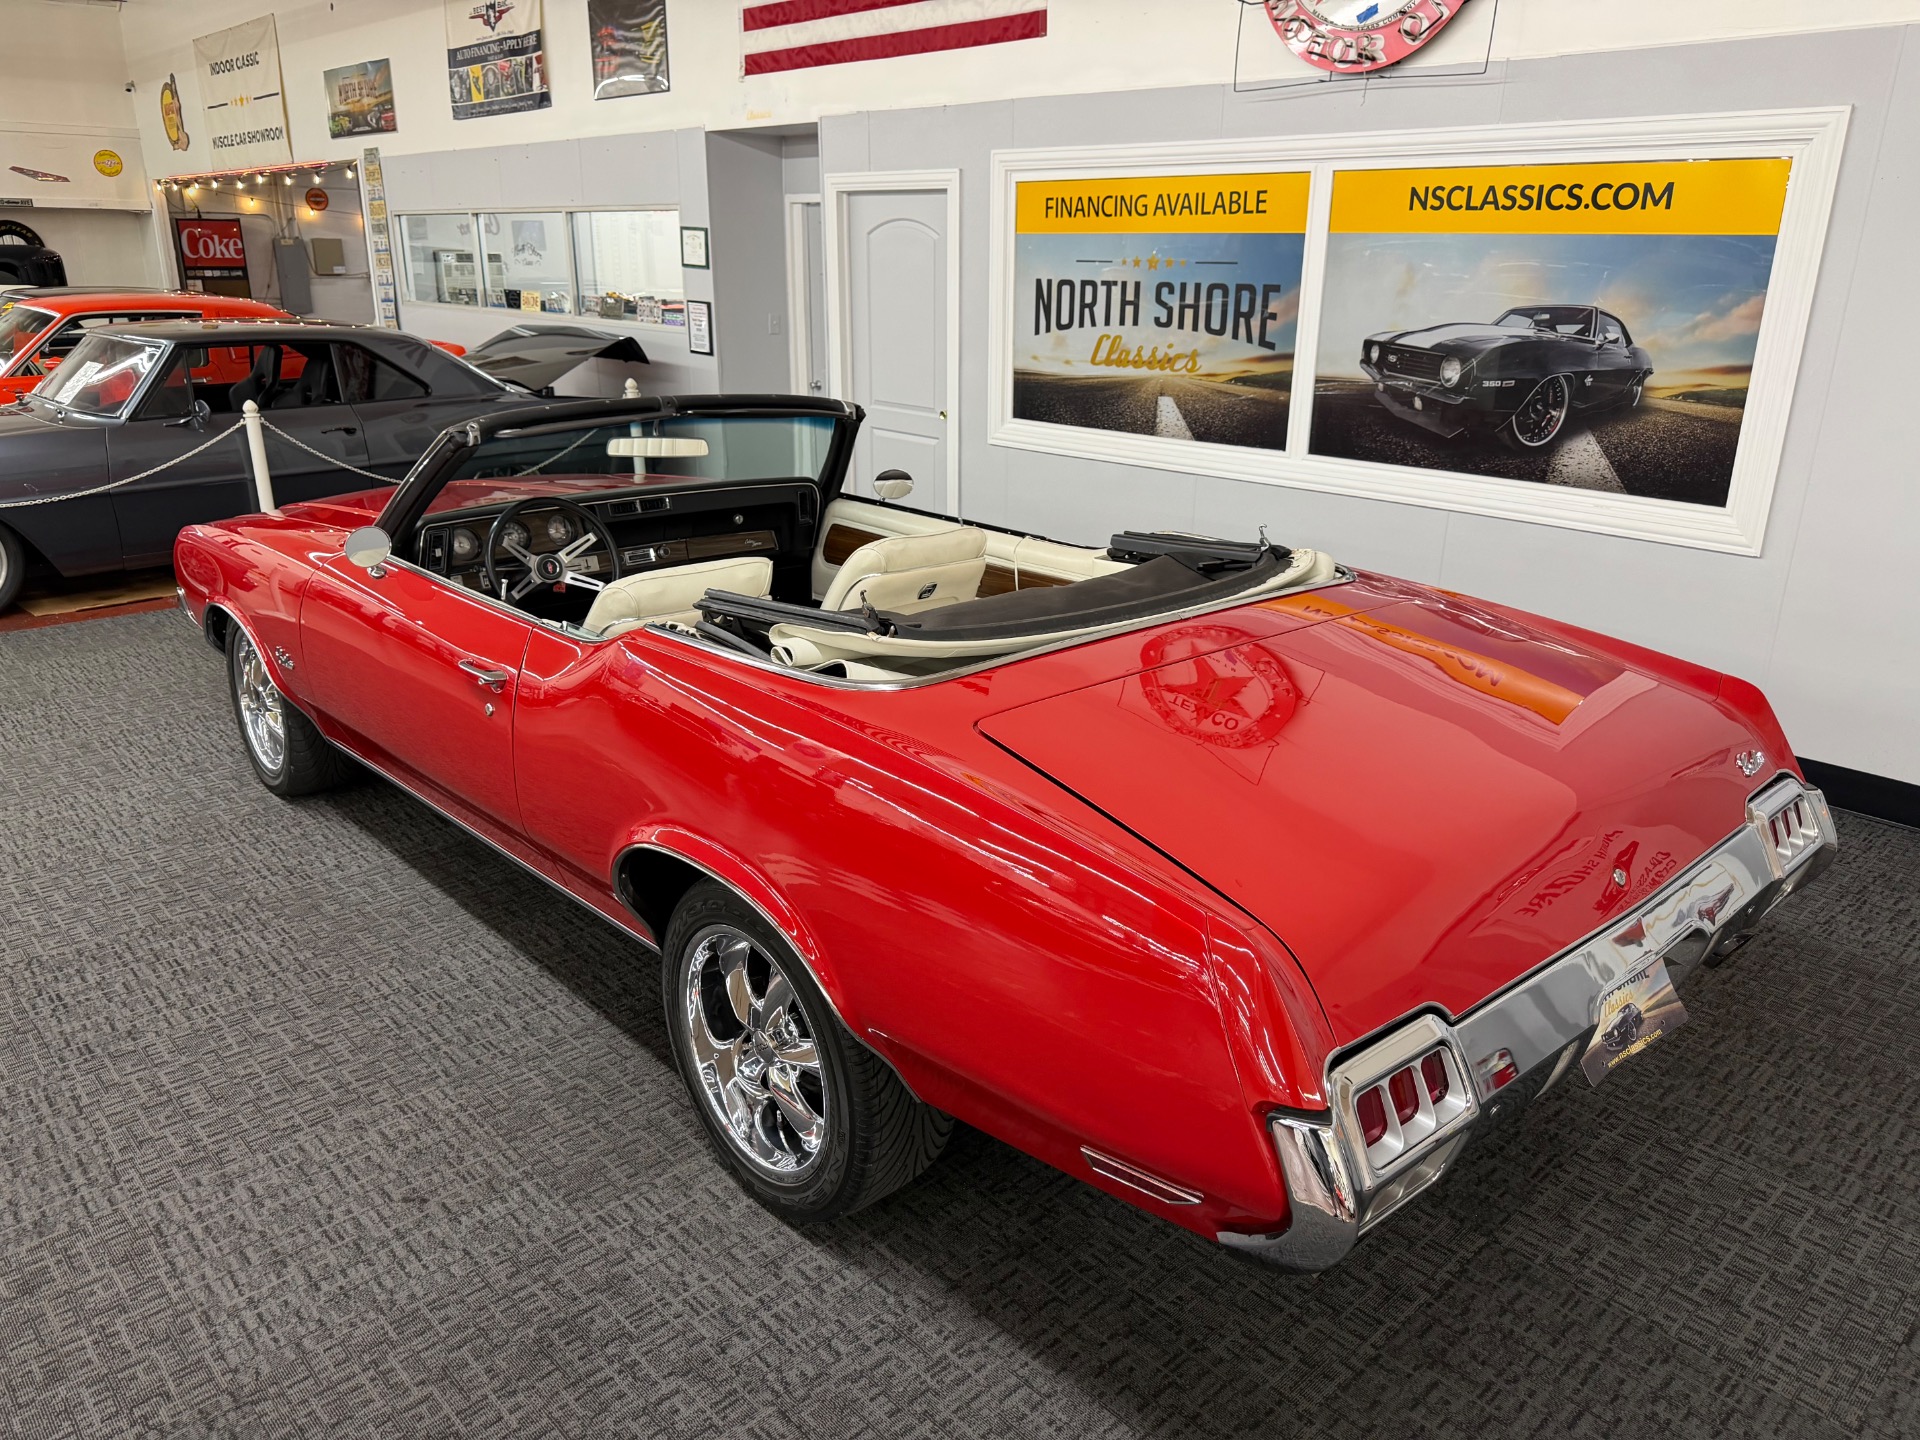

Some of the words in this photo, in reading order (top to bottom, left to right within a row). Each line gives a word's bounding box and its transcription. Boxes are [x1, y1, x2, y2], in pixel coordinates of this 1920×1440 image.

[1382, 0, 1416, 24] COMNY
[503, 38, 522, 51] APPLY
[523, 33, 538, 47] HERE
[209, 58, 235, 76] INDOOR
[212, 134, 235, 149] MUSCLE
[235, 132, 247, 146] CAR
[247, 126, 284, 144] SHOWROOM
[1044, 193, 1149, 219] FINANCING
[1152, 189, 1268, 217] AVAILABLE
[1407, 180, 1676, 212] NSCLASSICS.COM
[181, 228, 244, 258] Coke
[1034, 278, 1142, 336] NORTH
[1153, 281, 1282, 351] SHORE
[1090, 333, 1203, 374] Classics
[1604, 989, 1634, 1018] Classics
[1607, 1028, 1663, 1069] www.nsclassics.com
